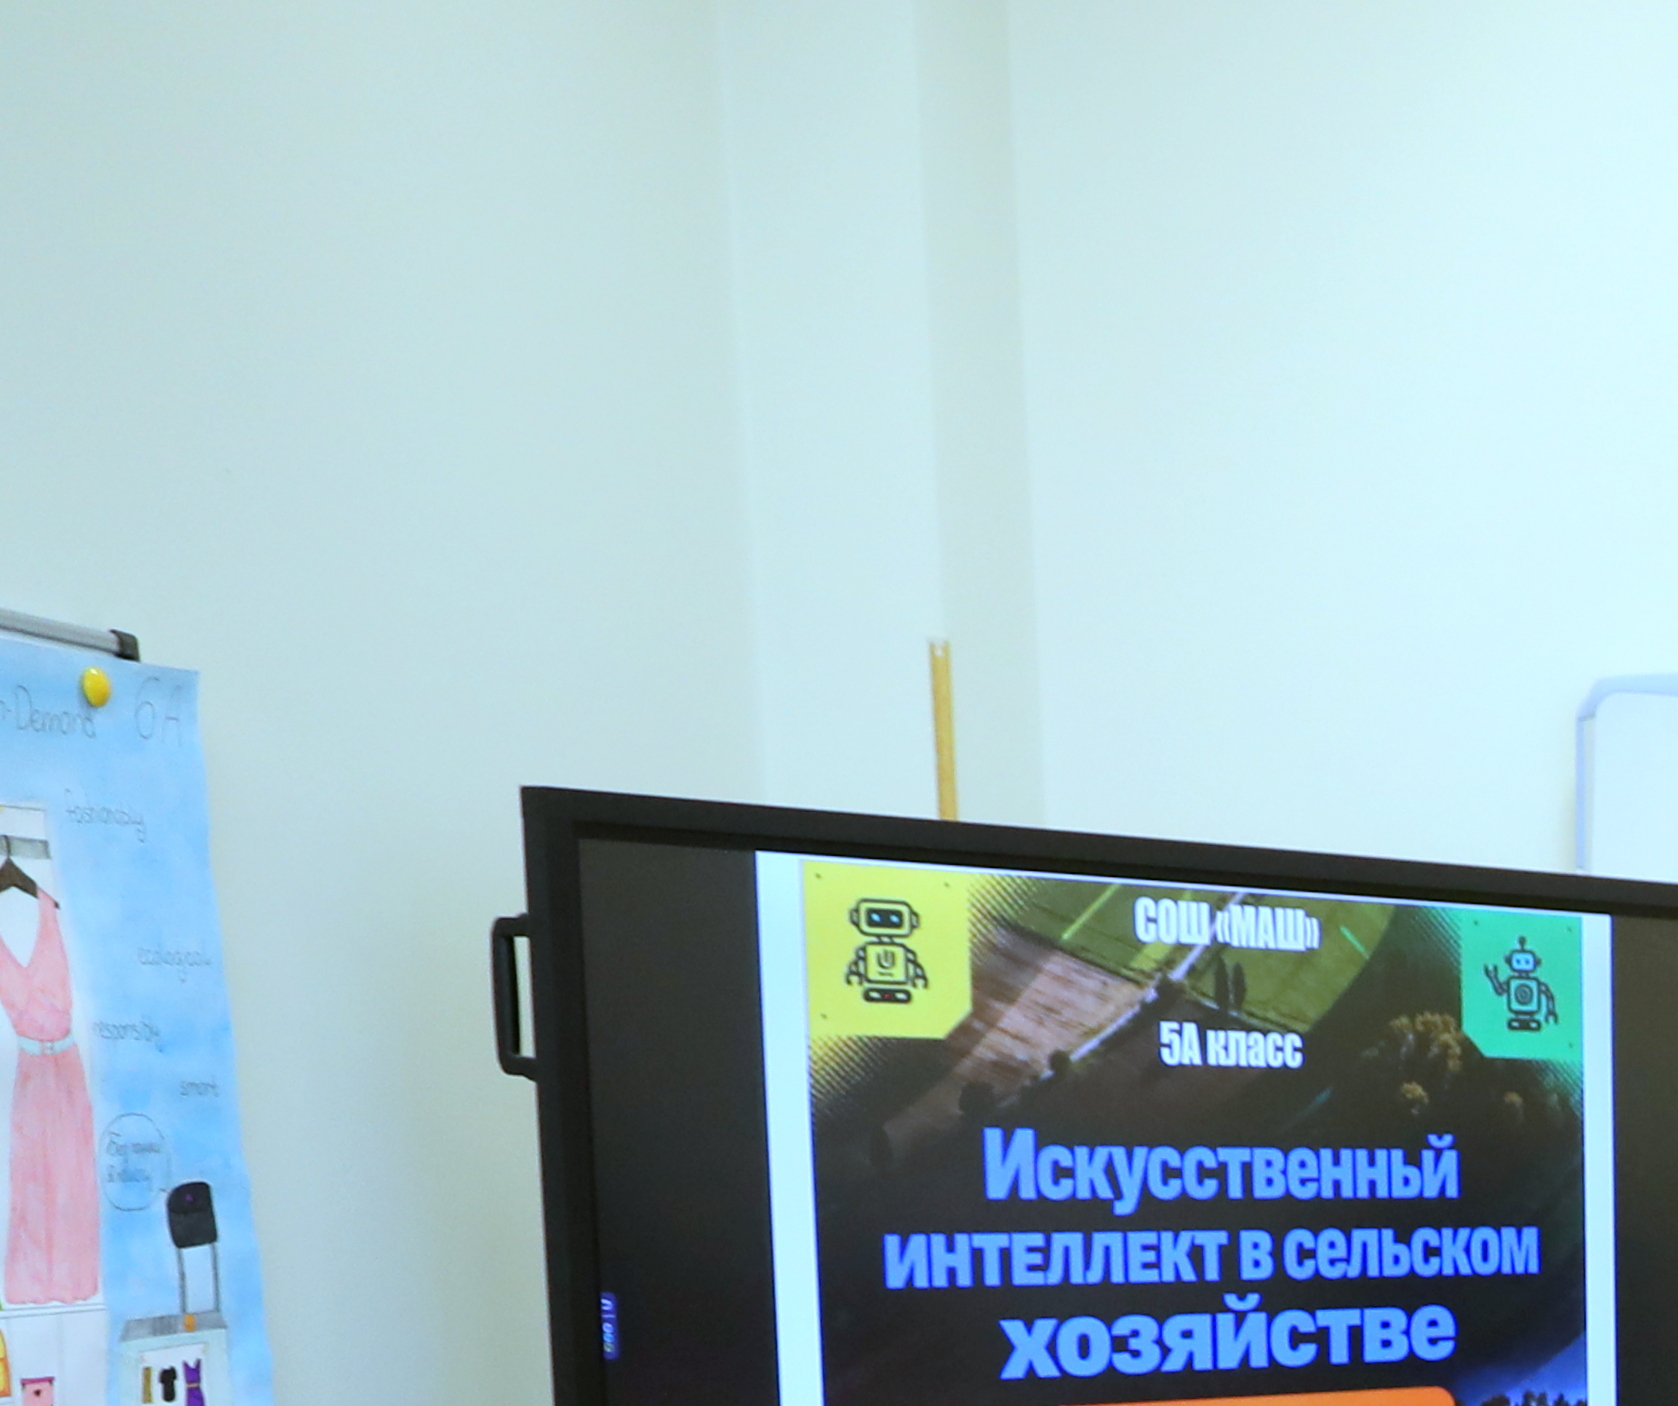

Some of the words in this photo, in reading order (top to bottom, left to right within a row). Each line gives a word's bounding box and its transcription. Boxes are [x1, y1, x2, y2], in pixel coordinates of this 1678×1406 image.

[1134, 896, 1212, 946] СОШ
[1159, 1020, 1203, 1067] 5А
[1206, 1028, 1304, 1069] класс
[1000, 1292, 1458, 1380] хозяйстве
